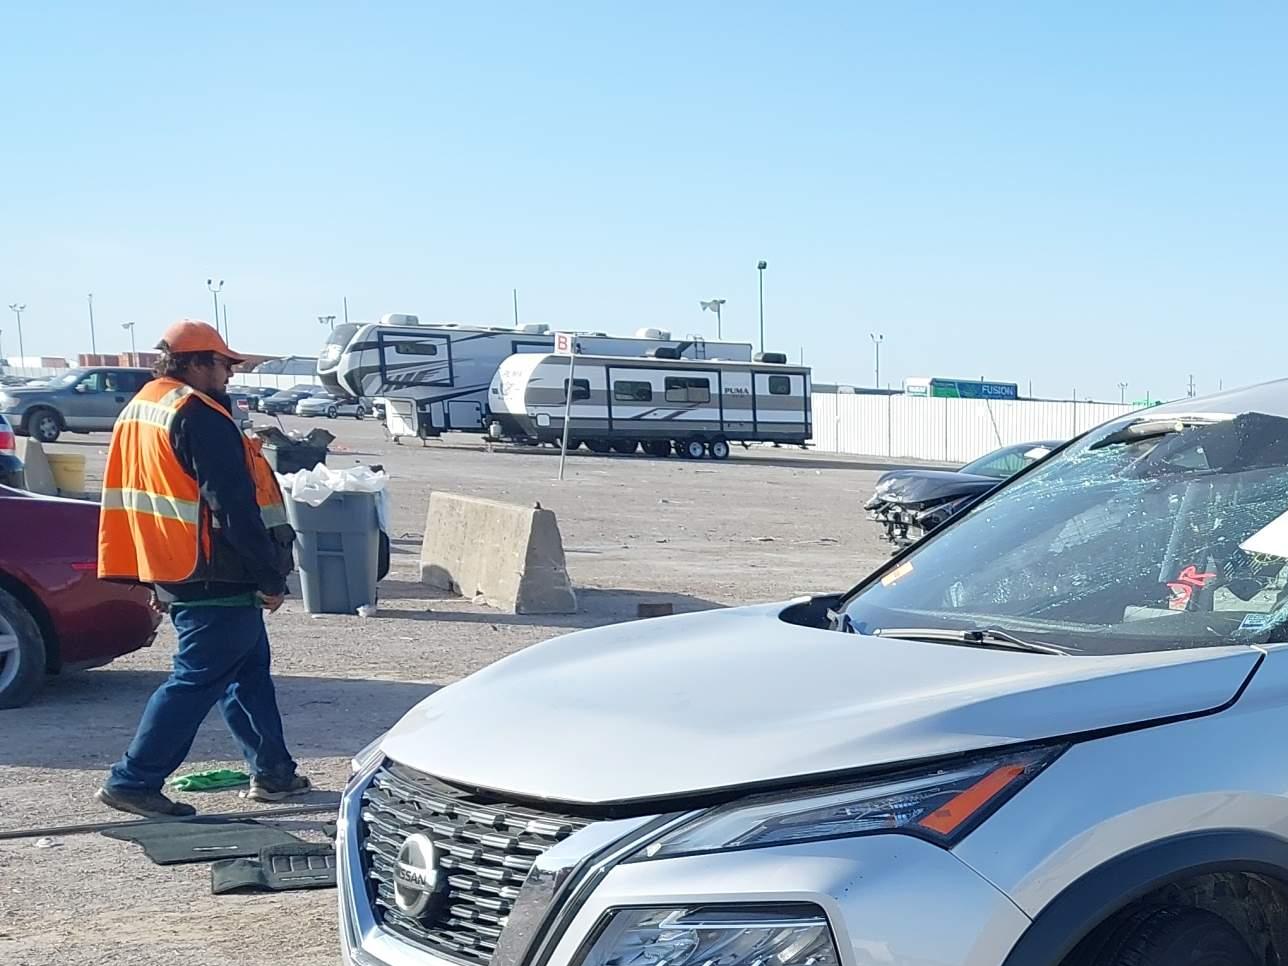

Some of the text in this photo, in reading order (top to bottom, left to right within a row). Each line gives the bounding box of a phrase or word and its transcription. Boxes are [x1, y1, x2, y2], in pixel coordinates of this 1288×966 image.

[557, 335, 568, 350] B
[982, 384, 1014, 396] FUSION
[394, 864, 427, 886] SSAN
